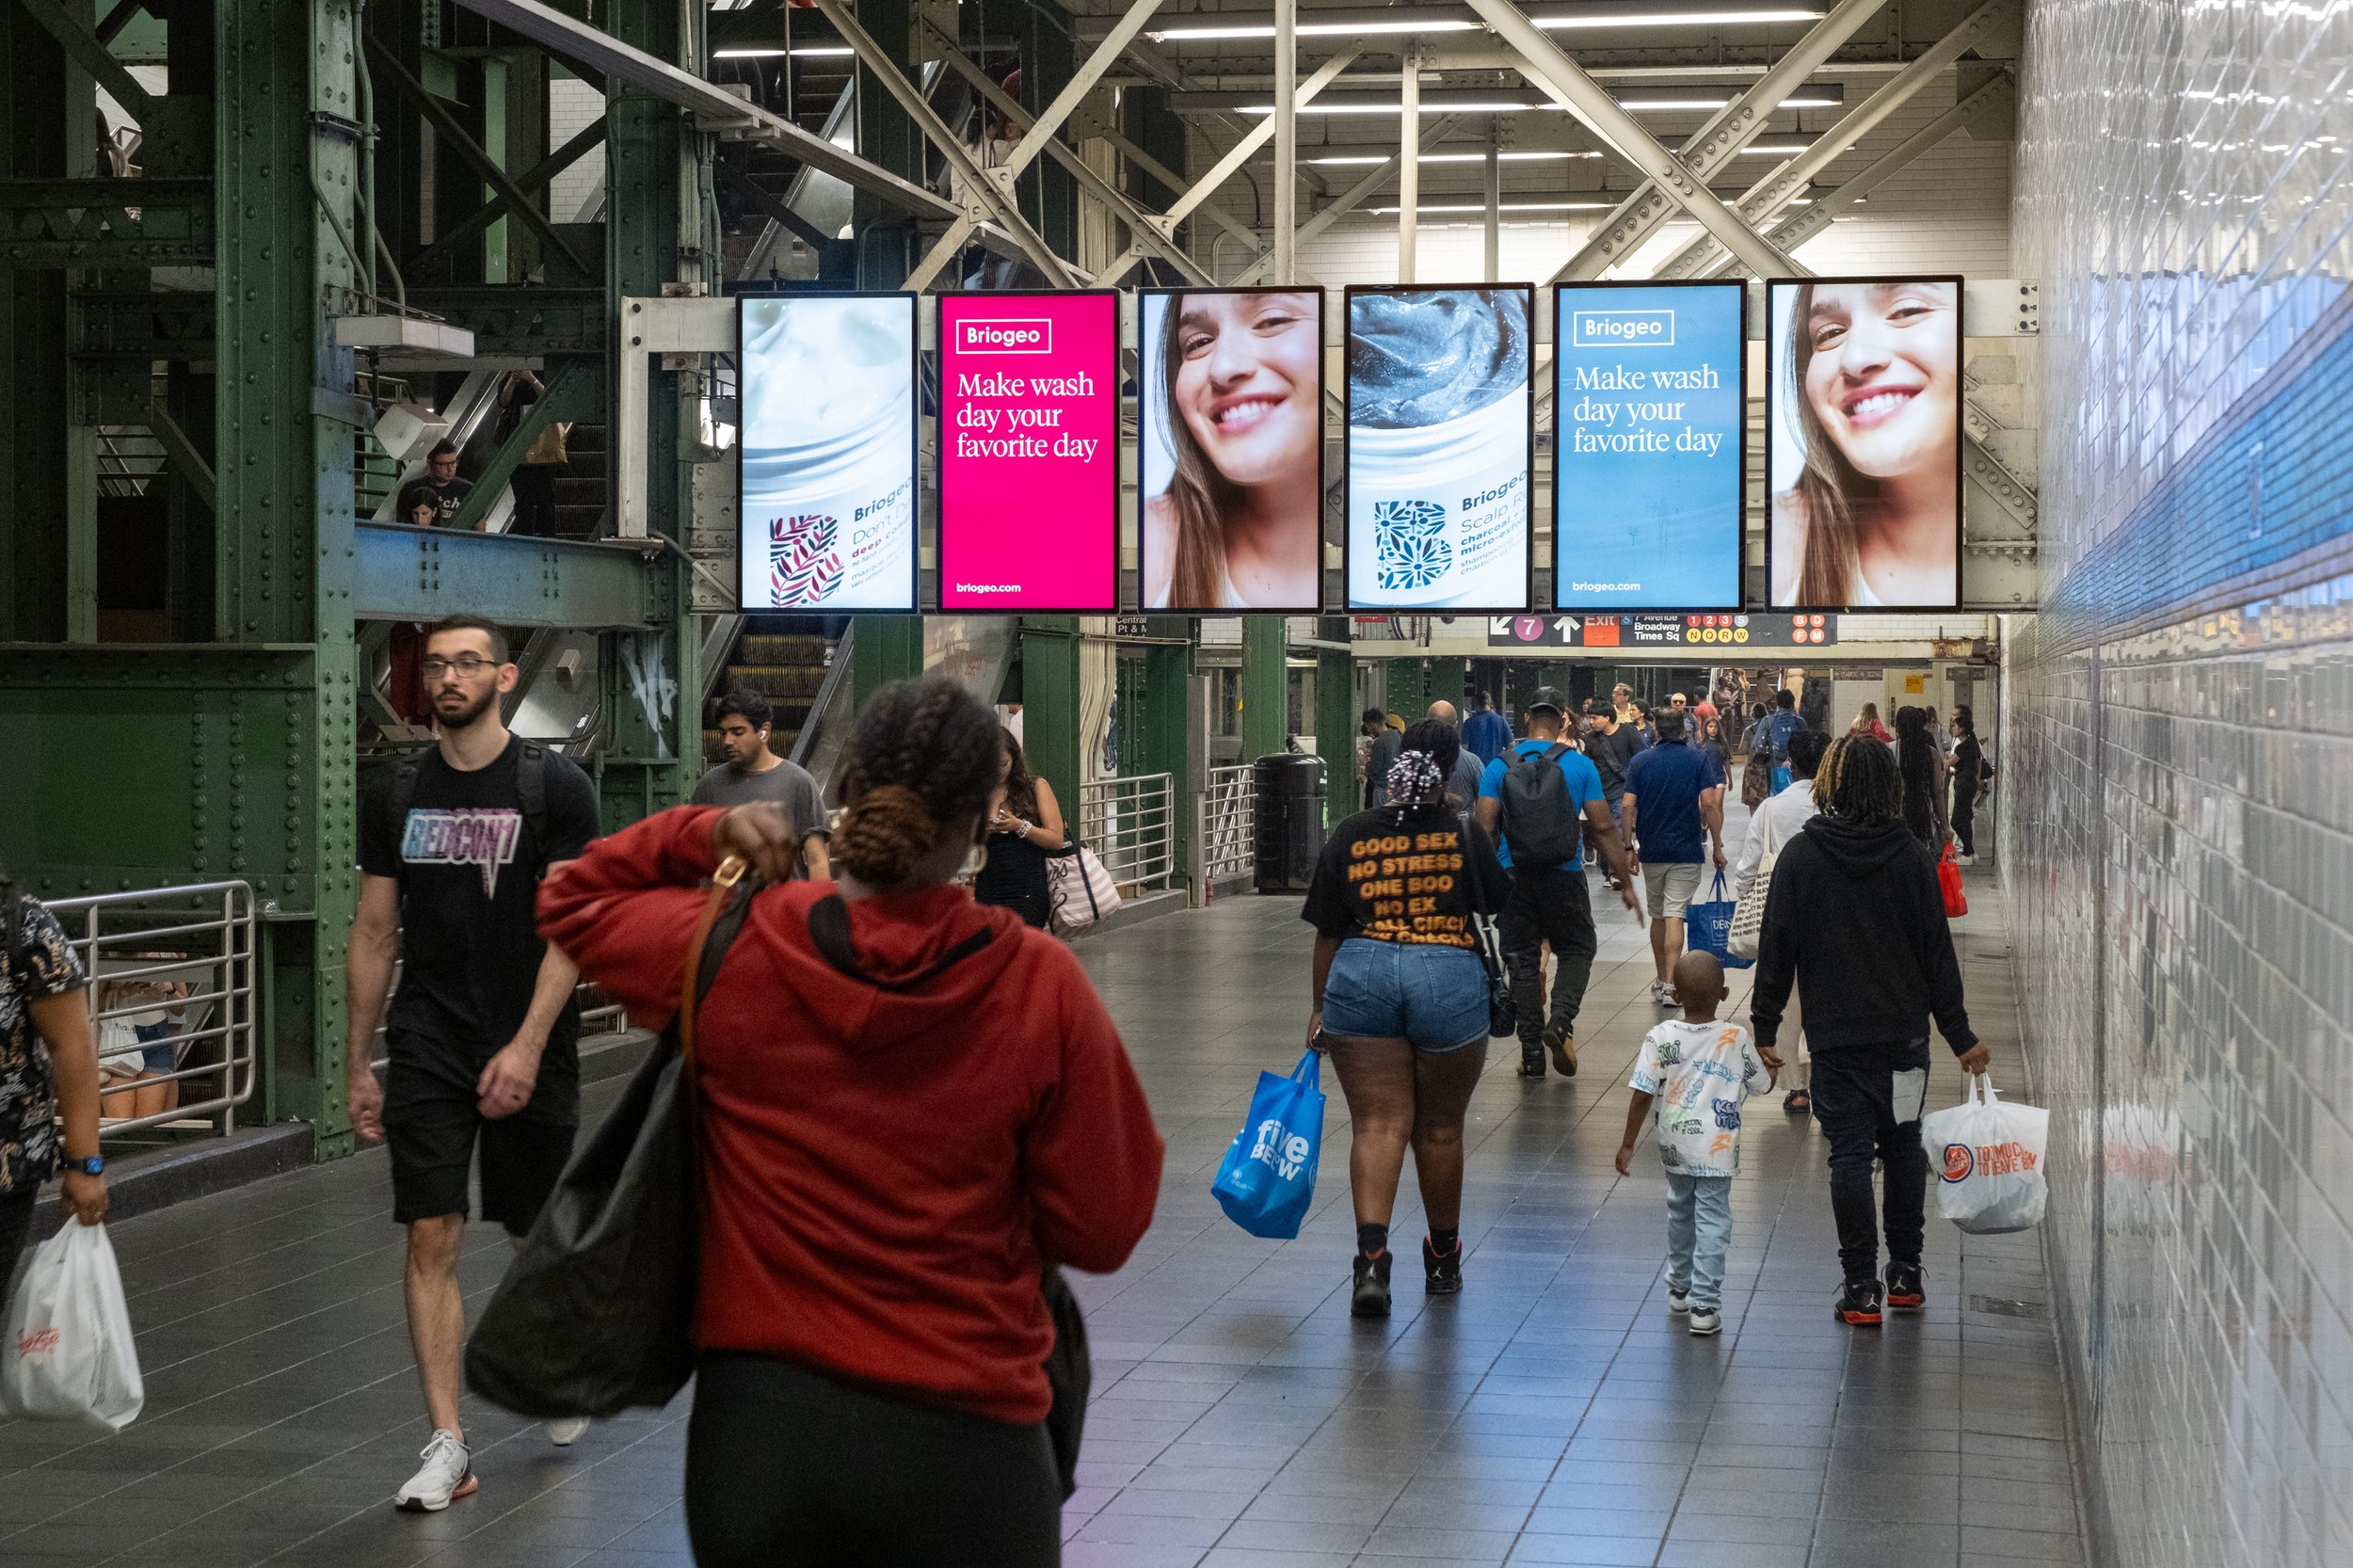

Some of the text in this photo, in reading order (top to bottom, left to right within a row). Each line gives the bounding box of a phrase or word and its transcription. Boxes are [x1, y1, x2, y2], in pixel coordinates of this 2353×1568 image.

[967, 327, 1040, 348] Briogeo
[1585, 317, 1662, 339] Briogeo
[956, 371, 1096, 397] Make wash
[1573, 362, 1721, 391] Make wash
[956, 403, 1063, 434] day your
[1573, 395, 1686, 427] day your
[956, 432, 1098, 463] favorite day
[1574, 425, 1723, 458] favorite day
[1461, 504, 1509, 534] Scalp
[1461, 518, 1511, 546] charcoal
[851, 537, 882, 558] deep
[956, 582, 1021, 595] briogeo.com
[1572, 581, 1641, 593] briogeo.com
[1115, 616, 1146, 624] Central
[1523, 619, 1536, 635] 7
[1584, 616, 1614, 626] Exit
[1634, 622, 1680, 632] Broadway
[1634, 632, 1680, 642] Times Sq
[1350, 832, 1459, 859] GOOD SEX
[1347, 854, 1465, 883] NO STRESS
[1360, 874, 1454, 901] ONE BOO
[1373, 896, 1437, 919] NO EX
[1257, 1119, 1309, 1163] five
[1250, 1144, 1302, 1182] BELOW
